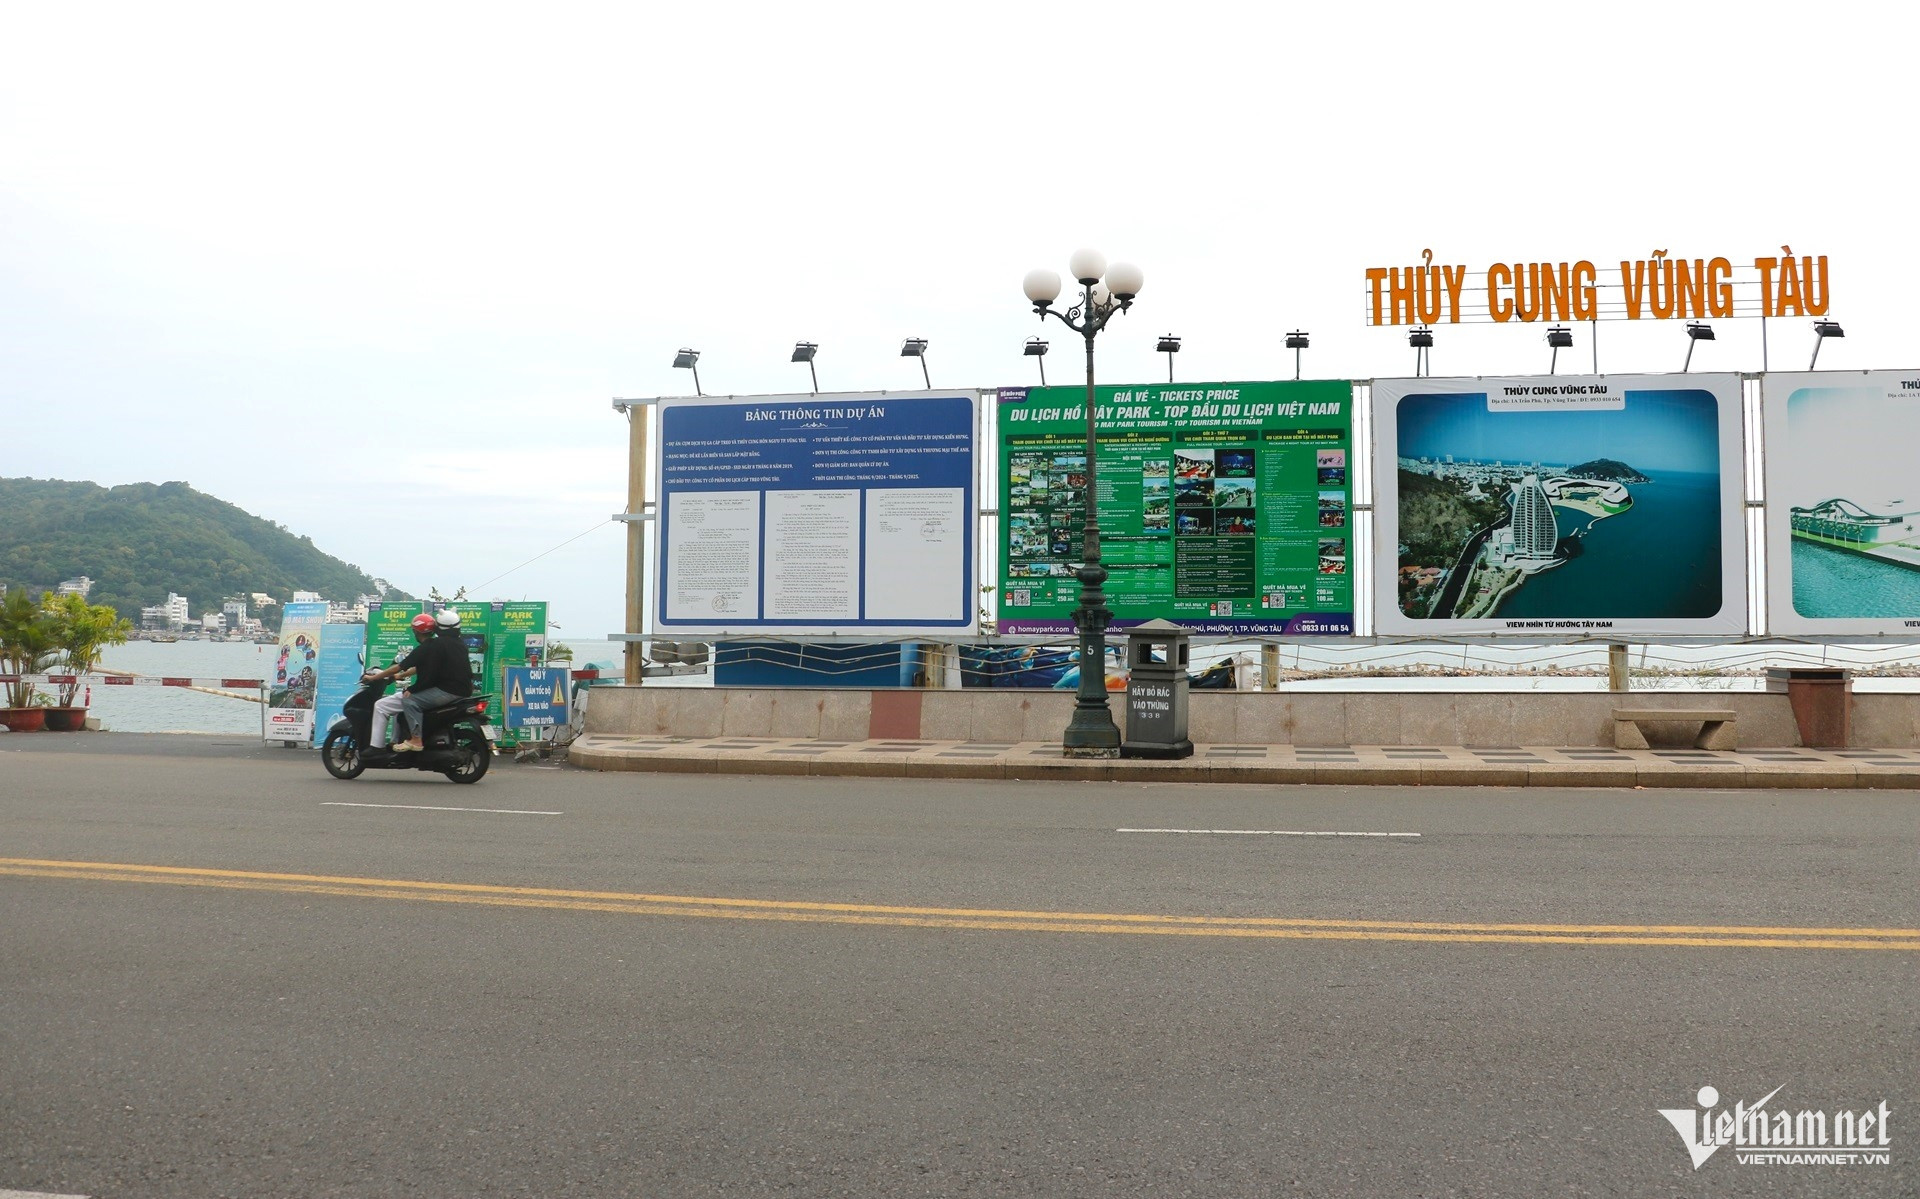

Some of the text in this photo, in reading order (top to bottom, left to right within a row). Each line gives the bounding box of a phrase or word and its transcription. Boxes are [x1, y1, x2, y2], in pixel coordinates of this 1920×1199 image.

[1366, 245, 1829, 326] THỦY CUNG VŨNG TÀU
[1504, 384, 1607, 395] THỦY CUNG VŨNG TÀU
[1113, 389, 1132, 402] GIÁ
[1135, 389, 1149, 402] VÉ
[1159, 390, 1204, 402] TICKETS
[1206, 389, 1240, 401] PRICE
[745, 405, 885, 421] BẢNG THÔNG TIN DỰ ÁN
[1010, 409, 1028, 421] DU
[1031, 408, 1060, 423] LỊCH
[1116, 406, 1151, 419] PARK
[1164, 405, 1189, 418] TOP
[1221, 404, 1241, 416] DU
[1243, 403, 1274, 419] LỊCH
[1278, 400, 1306, 418] VIỆT
[1308, 402, 1341, 415] NAM
[384, 611, 407, 620] LỊCH
[505, 611, 533, 619] PARK
[1207, 624, 1233, 632] PHƯỜNG
[1250, 623, 1269, 632] VŨNG
[1269, 624, 1282, 632] TÀU
[1525, 620, 1543, 628] NHÌN
[1544, 620, 1554, 628] TỪ
[1555, 620, 1580, 628] HƯỚNG
[1581, 620, 1594, 628] TÂY
[1018, 626, 1070, 634] homaypark.com
[1087, 645, 1094, 656] 5
[530, 668, 546, 680] CHÚ Ý
[524, 684, 552, 696] GIẢM TỐC ĐỘ
[1132, 685, 1170, 697] HÃY BỎ RÁC
[528, 700, 549, 710] XE RA VÀO
[1132, 699, 1169, 710] VÀO THÙNG
